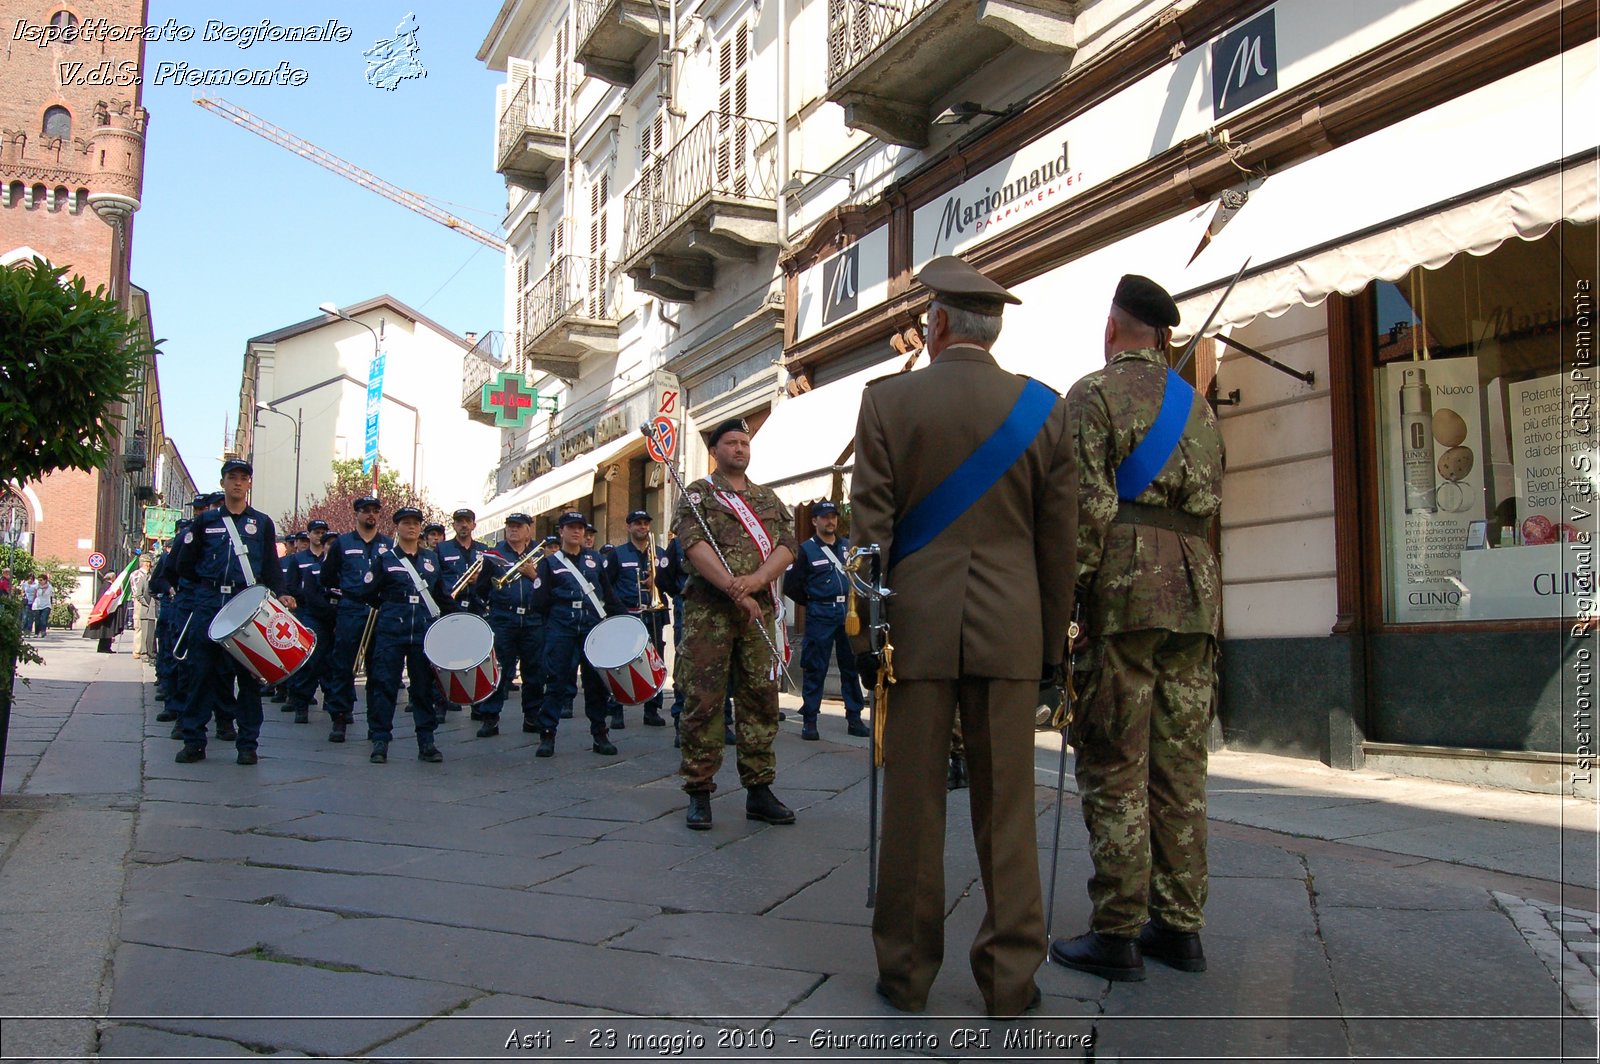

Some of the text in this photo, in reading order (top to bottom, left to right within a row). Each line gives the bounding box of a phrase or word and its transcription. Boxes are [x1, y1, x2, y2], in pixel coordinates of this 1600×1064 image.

[932, 140, 1071, 256] Marionnaud
[975, 172, 1083, 233] PARFUMERIES
[1436, 385, 1474, 396] Nuovo
[1521, 386, 1562, 402] Potente
[1522, 405, 1531, 416] le
[1523, 419, 1539, 432] più
[1524, 431, 1552, 445] attivo
[1525, 447, 1540, 459] dai
[1527, 480, 1554, 493] Even
[1528, 495, 1556, 508] Siero
[734, 502, 756, 528] INTER
[1434, 519, 1458, 527] contro
[1445, 527, 1466, 535] come
[1533, 571, 1600, 596] CLINI
[1408, 591, 1462, 606] CLINIQ
